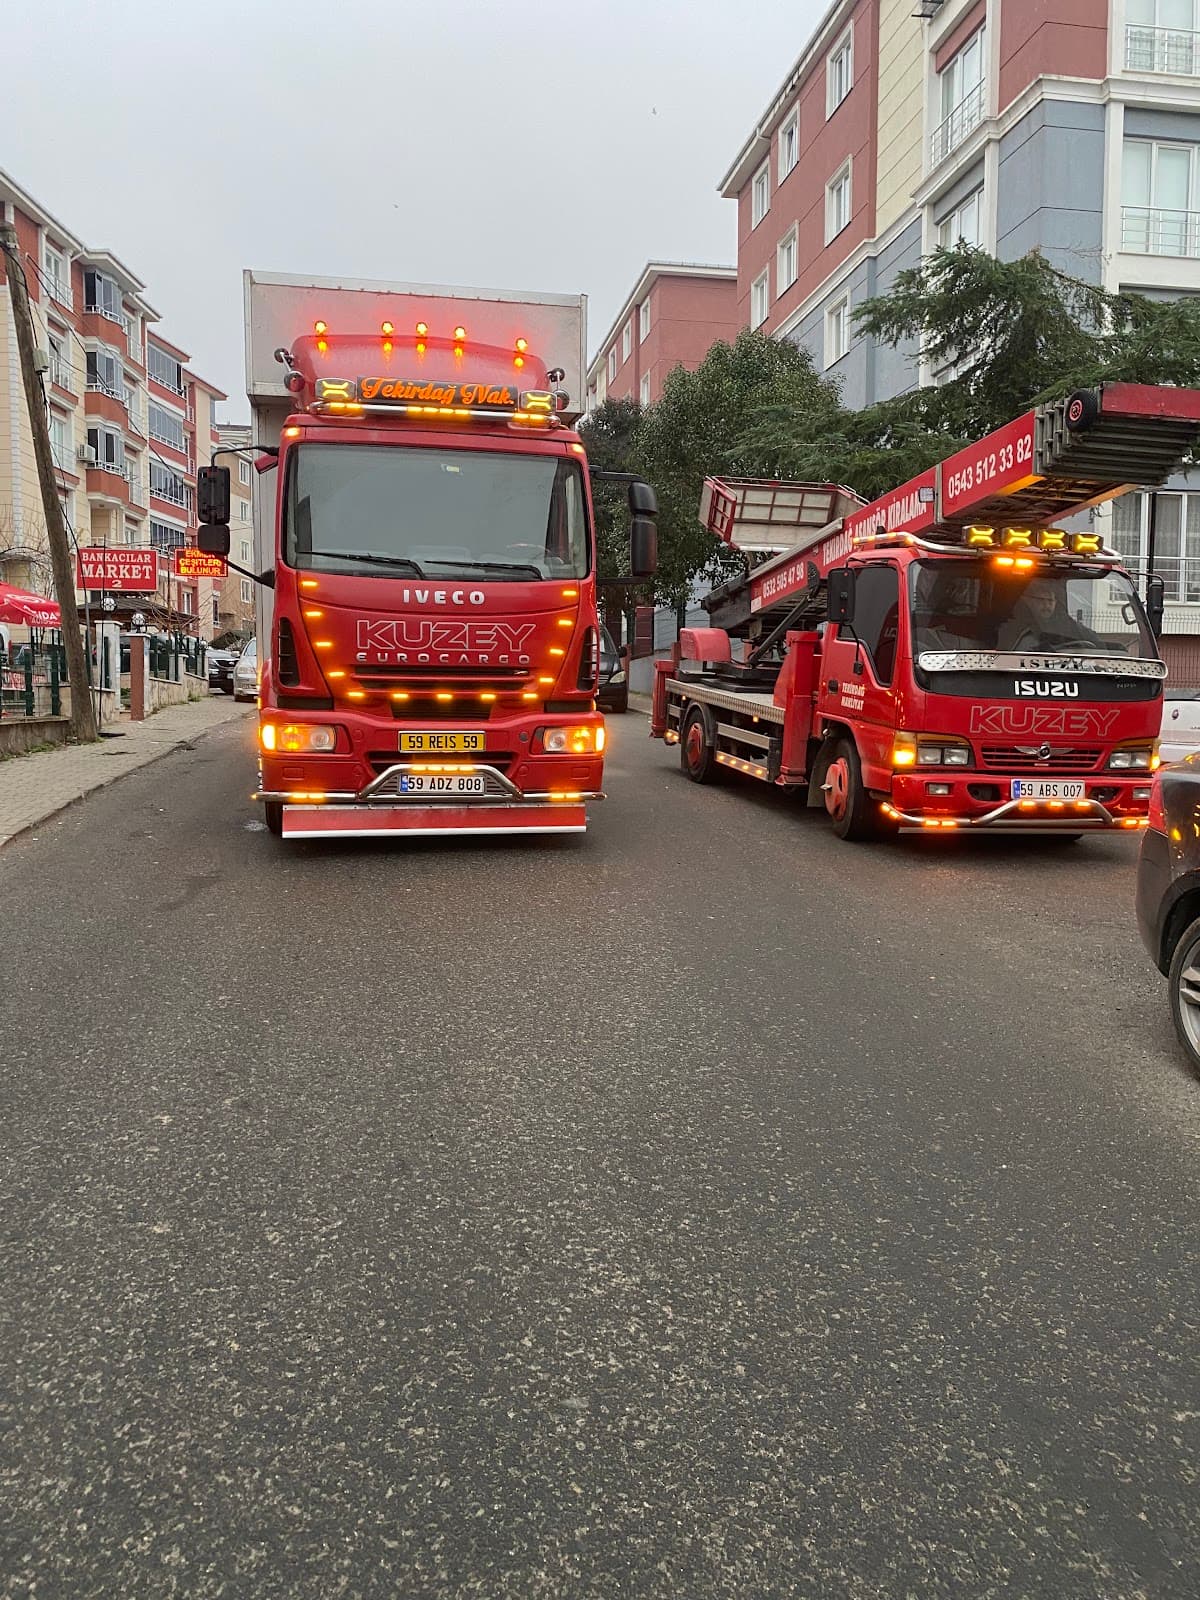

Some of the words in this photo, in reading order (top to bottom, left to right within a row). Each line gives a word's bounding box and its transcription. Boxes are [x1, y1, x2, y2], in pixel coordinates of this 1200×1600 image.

[361, 377, 457, 404] Tekirdağ
[460, 384, 515, 405] Nak.
[948, 466, 973, 499] 0543
[976, 453, 996, 485] 512
[999, 444, 1014, 473] 33
[1016, 434, 1032, 464] 82
[82, 552, 151, 563] BANKACILAR
[80, 564, 153, 579] MARKET
[180, 566, 221, 575] BULUNUR
[111, 579, 123, 588] 2
[762, 577, 776, 599] 0532
[788, 566, 796, 585] 47
[403, 589, 485, 605] IVECO
[356, 620, 536, 652] KUZEY
[356, 652, 530, 664] EUROCARGO
[1014, 680, 1079, 697] ISUZU
[969, 705, 1121, 736] KUZEY
[408, 735, 423, 749] 59
[429, 735, 456, 749] REIS
[464, 735, 478, 749] 59
[408, 777, 423, 790] 59
[429, 777, 452, 790] ADZ
[458, 778, 481, 790] 808
[1020, 783, 1033, 796] 59
[1039, 784, 1058, 797] ABS
[1063, 784, 1082, 798] 007
